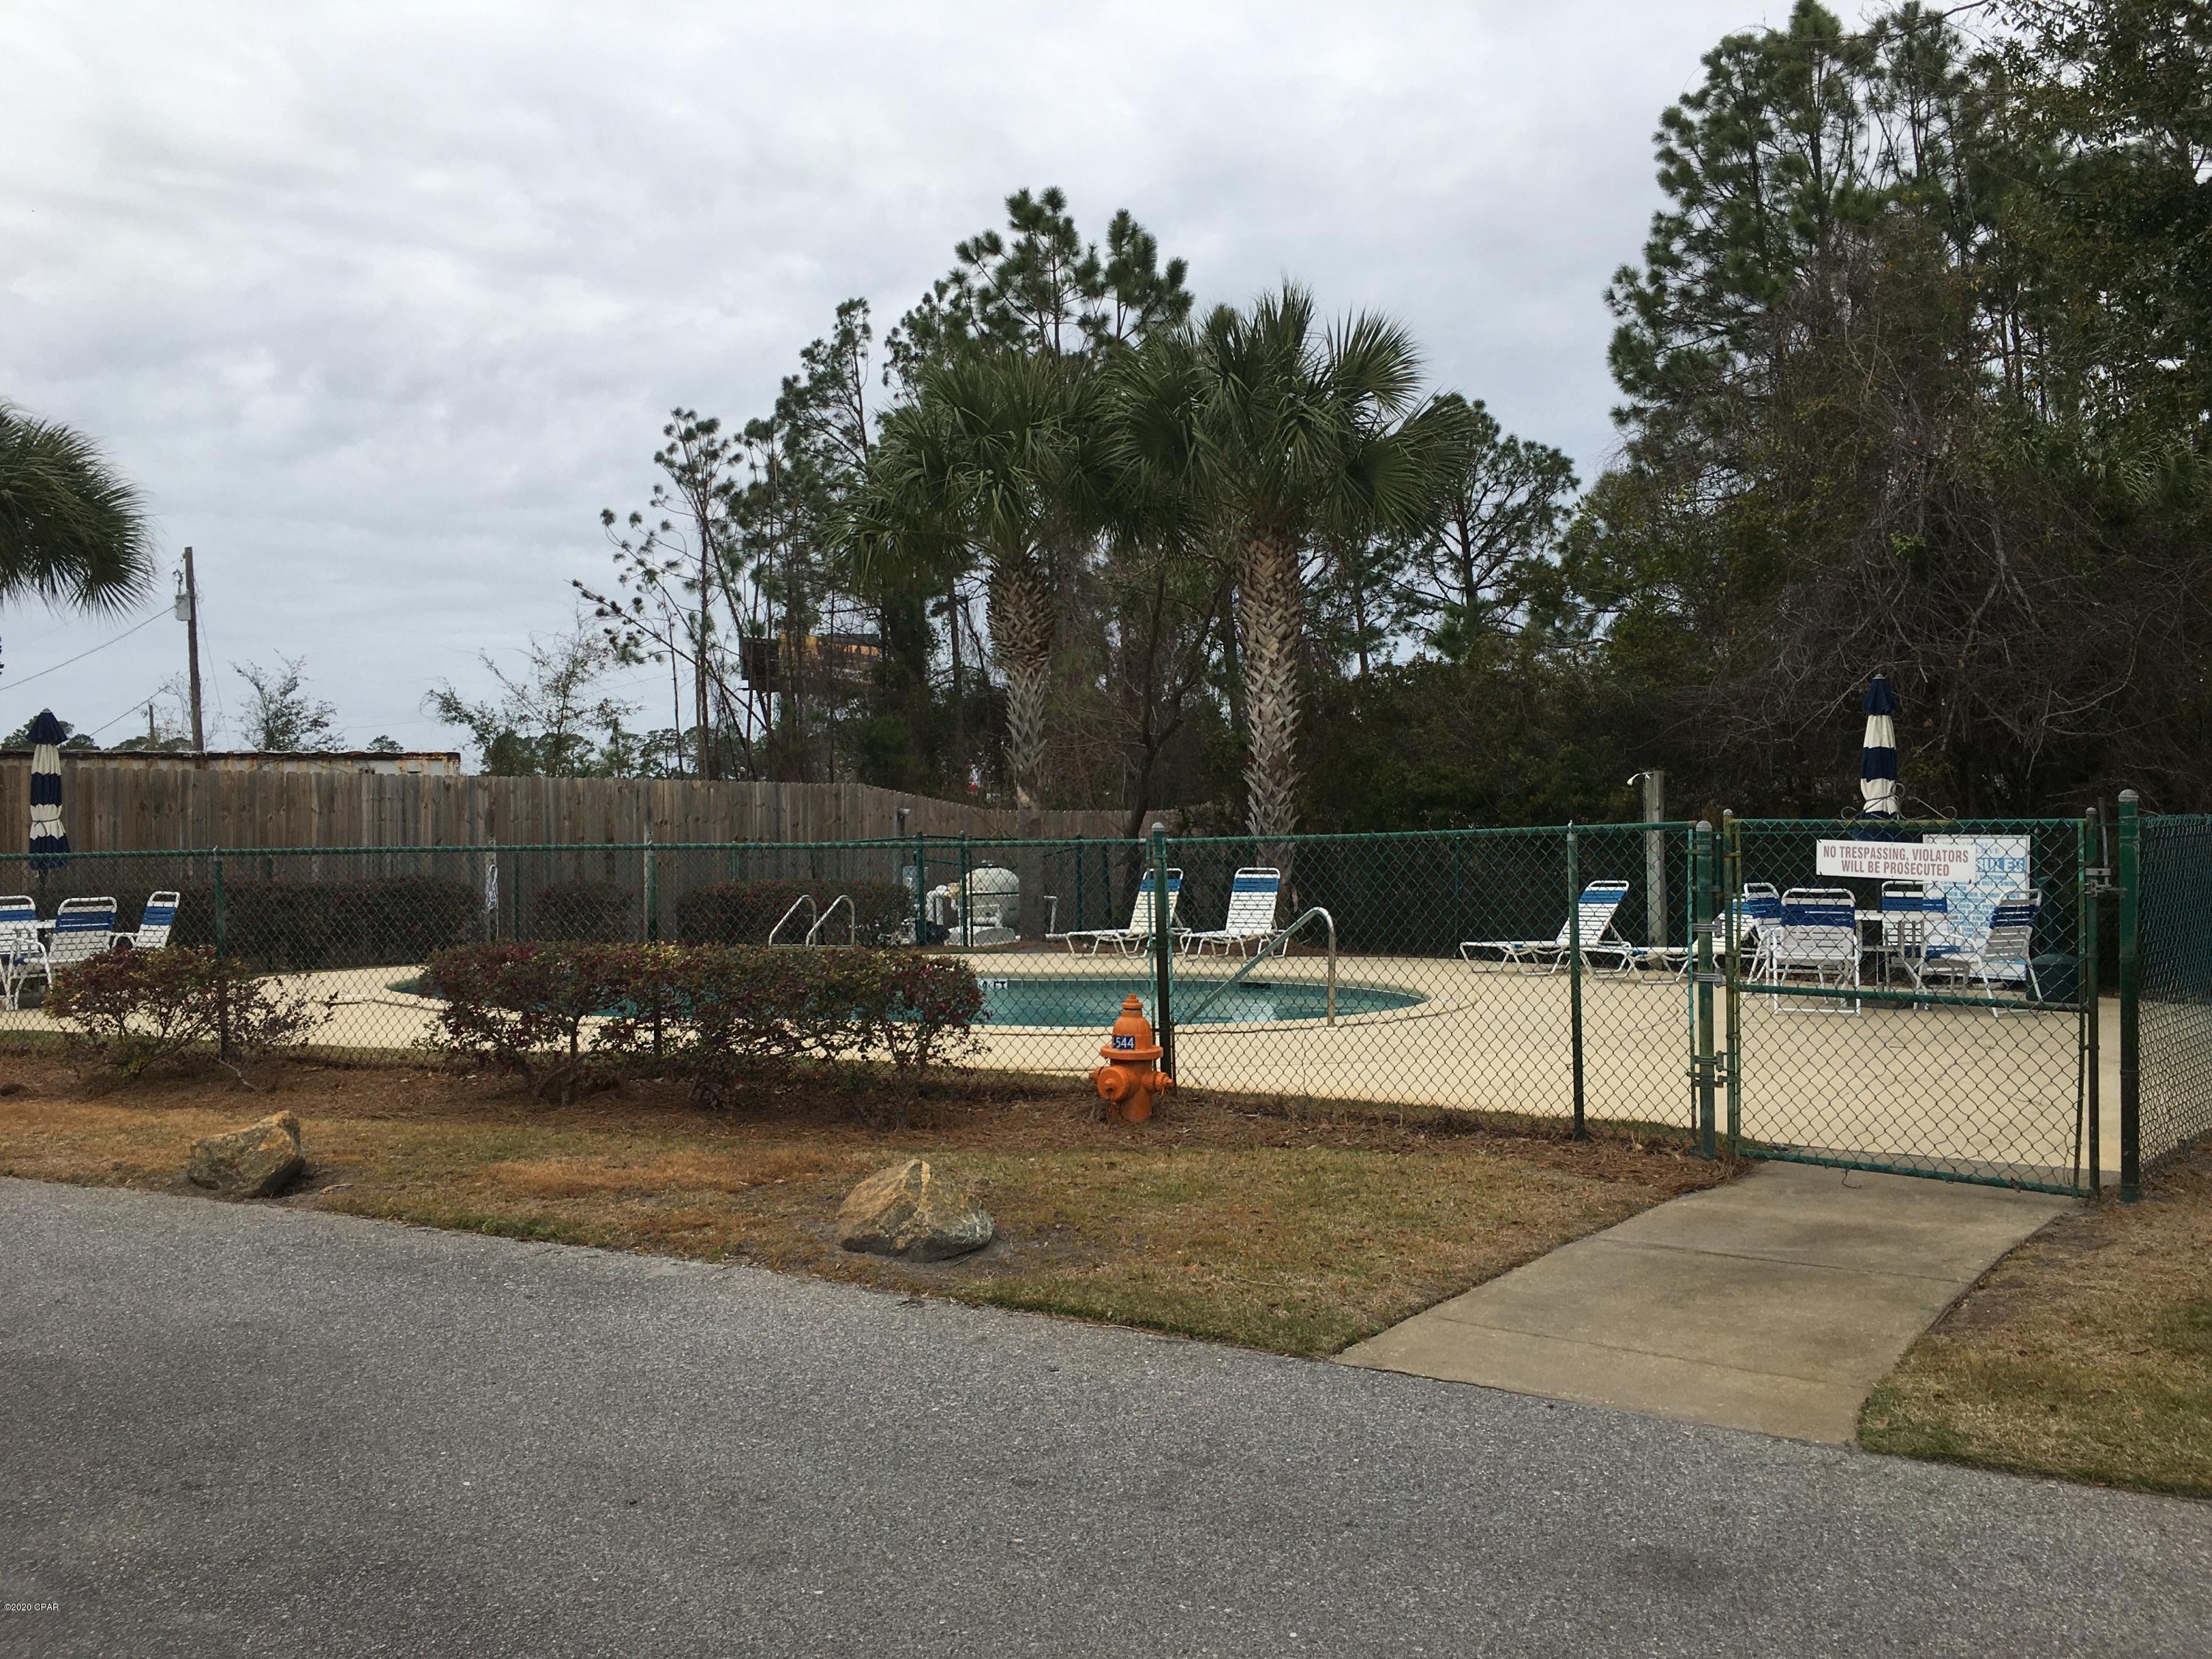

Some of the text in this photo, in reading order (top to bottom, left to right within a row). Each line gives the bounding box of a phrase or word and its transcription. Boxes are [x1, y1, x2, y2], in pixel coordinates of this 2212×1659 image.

[1823, 845, 1969, 863] NO TRESPASSING, VIOLATORS
[1841, 860, 1950, 877] WILL BE PROSECUTED
[1976, 858, 2025, 872] RULES
